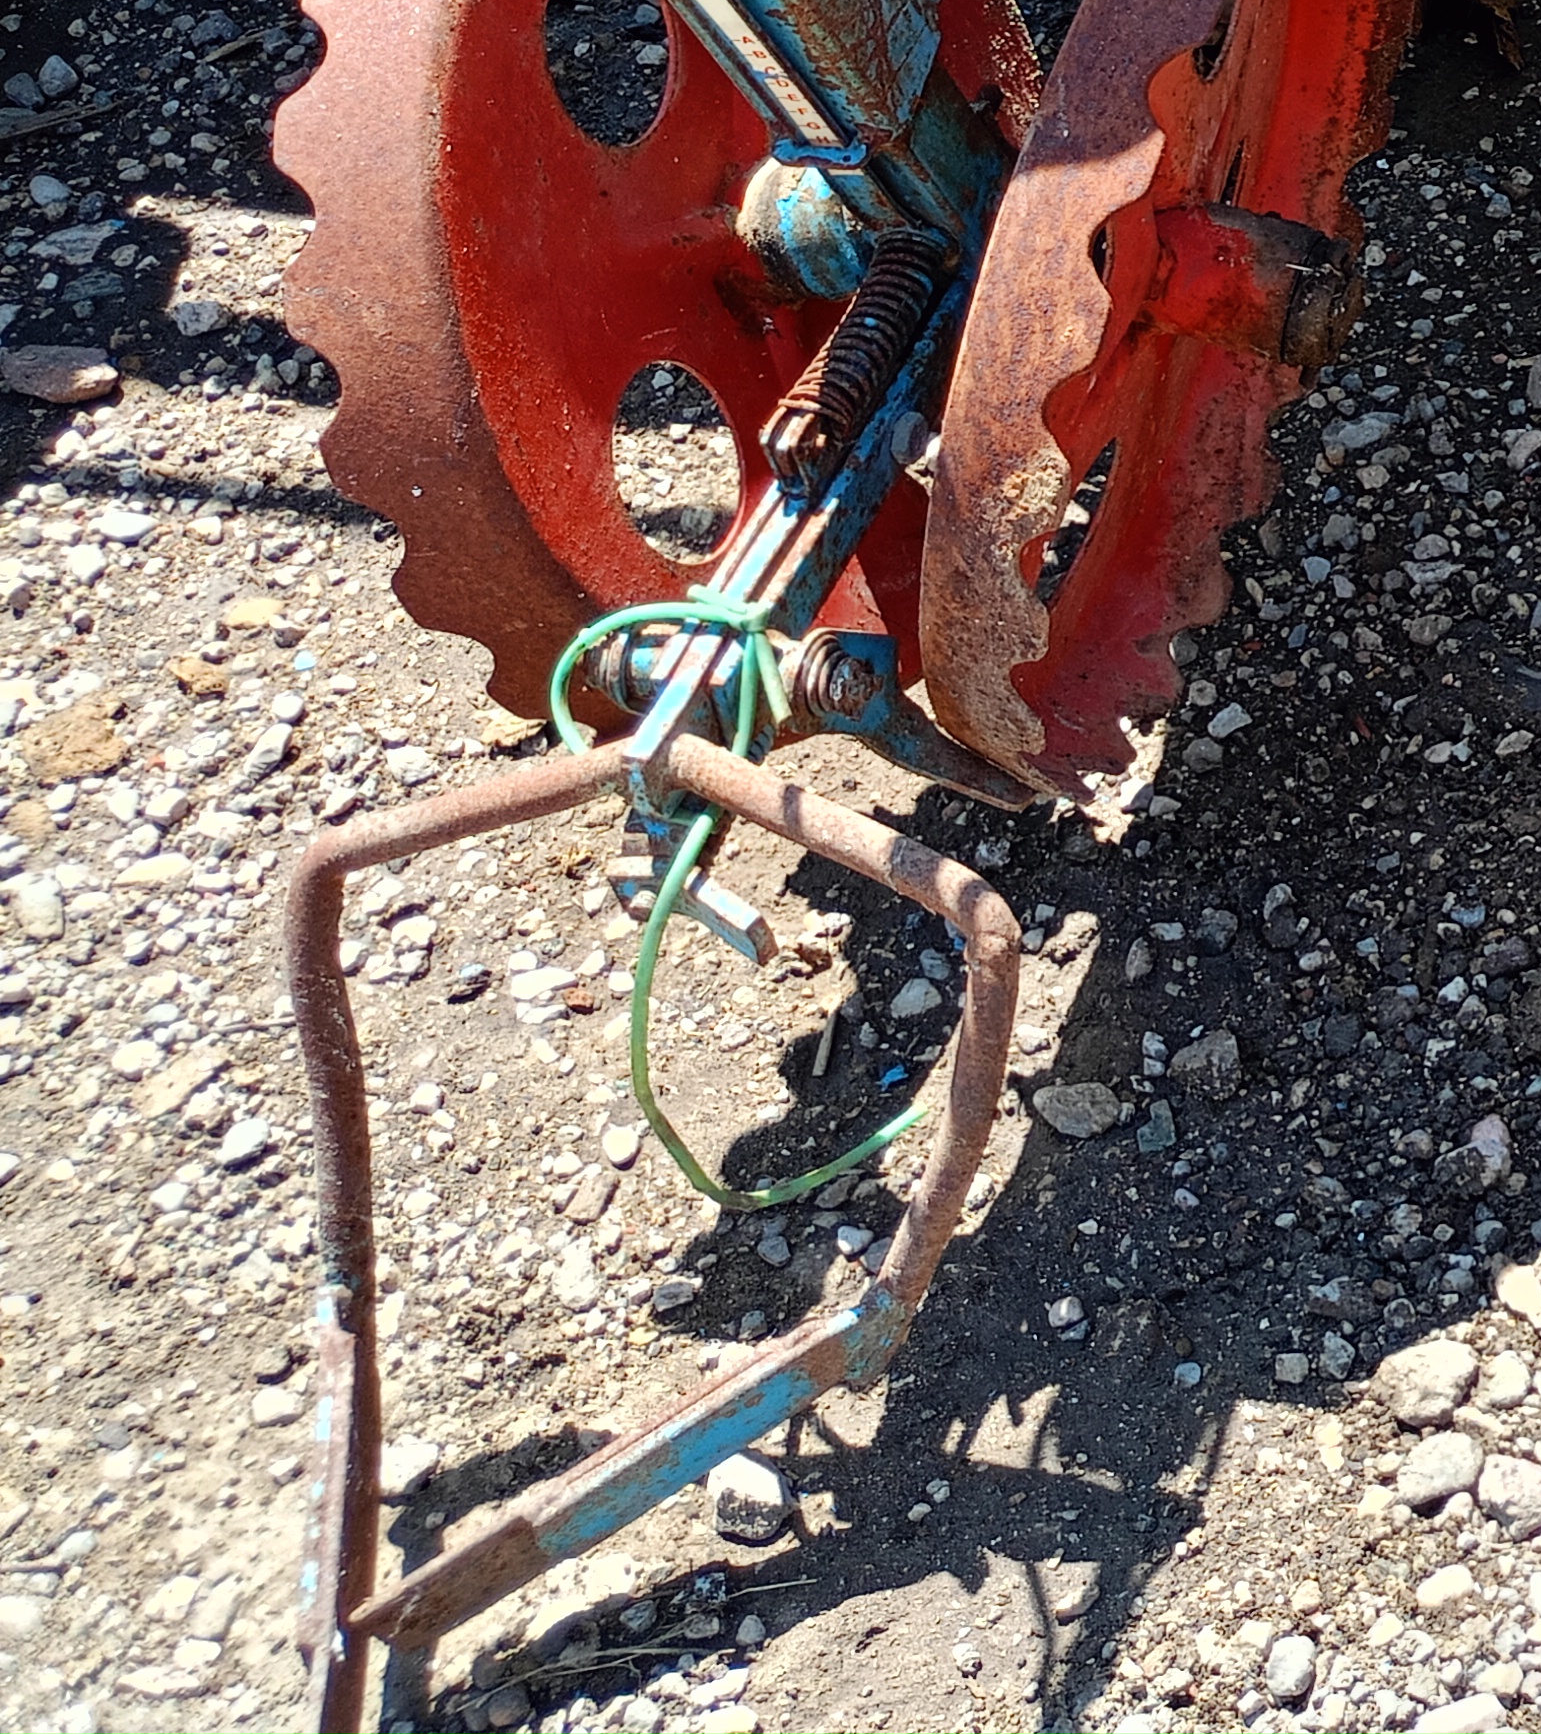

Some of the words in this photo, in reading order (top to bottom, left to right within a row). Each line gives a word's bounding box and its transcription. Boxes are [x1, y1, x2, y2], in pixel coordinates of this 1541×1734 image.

[742, 36, 755, 44] A
[752, 51, 767, 59] B
[776, 79, 790, 87] D
[787, 94, 800, 102] E
